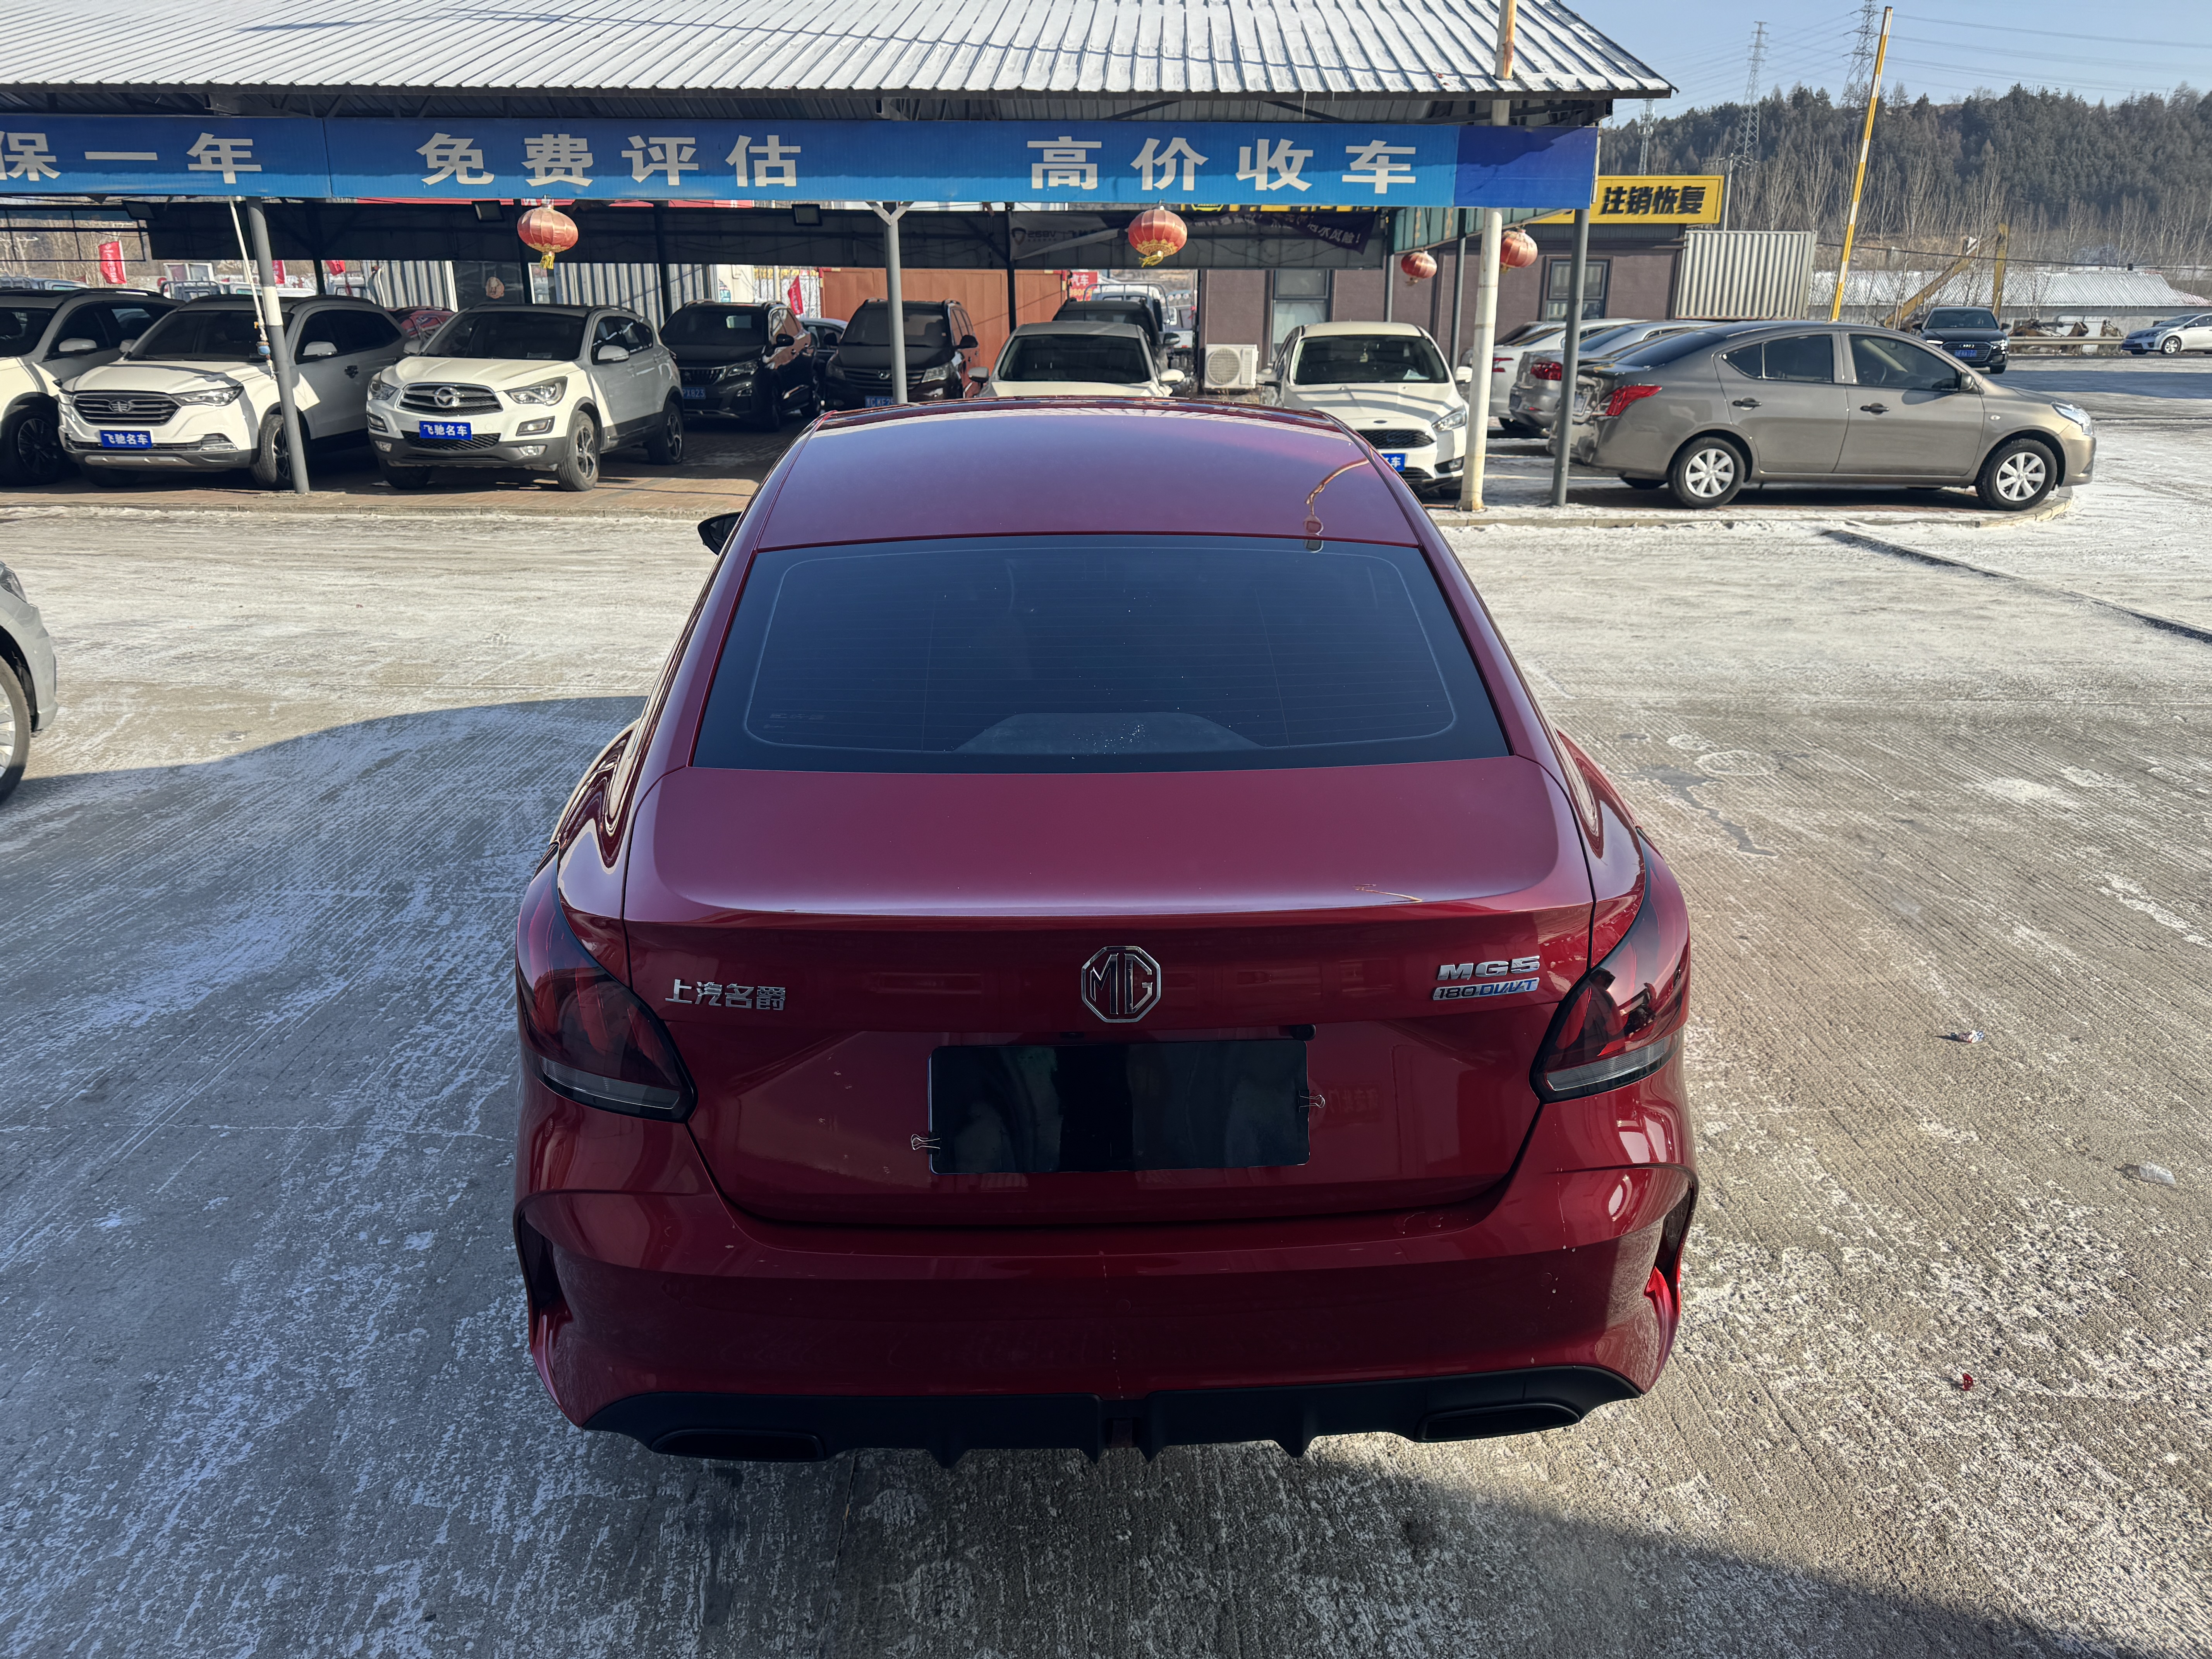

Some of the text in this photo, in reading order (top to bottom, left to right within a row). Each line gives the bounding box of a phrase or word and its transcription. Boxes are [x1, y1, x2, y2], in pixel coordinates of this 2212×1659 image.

[0, 131, 1416, 194] 保一年 免费评估 高价收车
[1600, 185, 1706, 215] 注销恢复
[103, 433, 149, 445] 飞驰名车
[423, 424, 468, 436] 飞驰名车
[1437, 955, 1540, 981] MG5
[665, 979, 786, 1011] 上汽名爵
[1089, 952, 1153, 1015] MG
